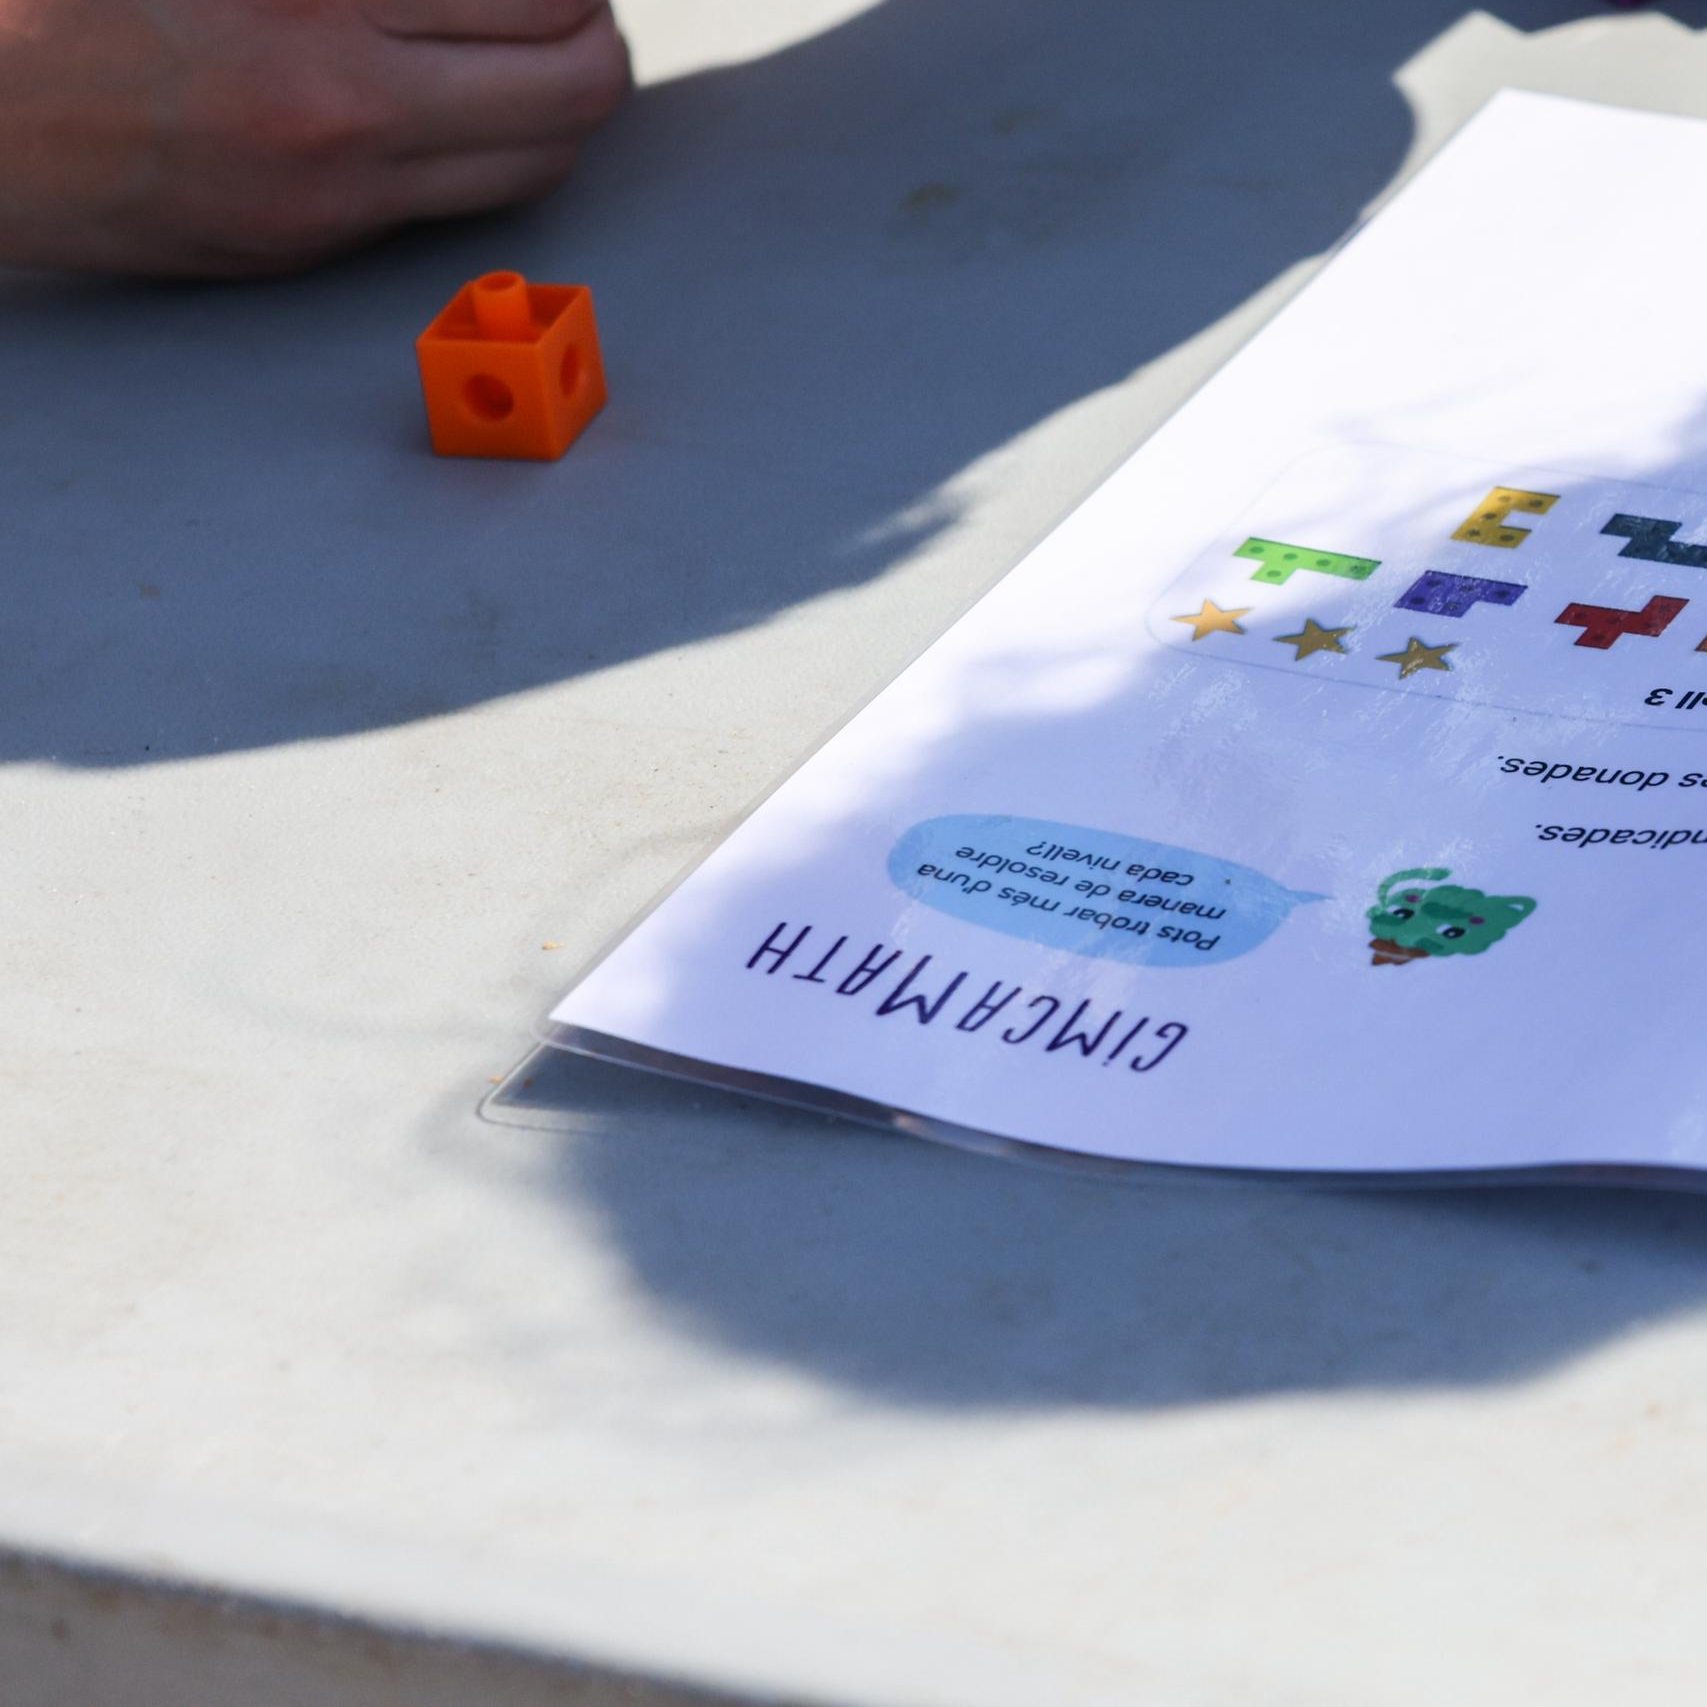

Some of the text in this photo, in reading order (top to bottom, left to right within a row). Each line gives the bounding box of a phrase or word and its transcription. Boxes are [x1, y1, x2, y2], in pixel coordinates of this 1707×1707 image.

[1644, 688, 1673, 706] 3
[1498, 756, 1670, 791] donades.
[1026, 841, 1194, 886] cada nivell?
[954, 845, 1226, 920] manera de resoldre
[997, 887, 1061, 912] més
[1063, 907, 1150, 936] trobar
[1156, 926, 1221, 951] Pots
